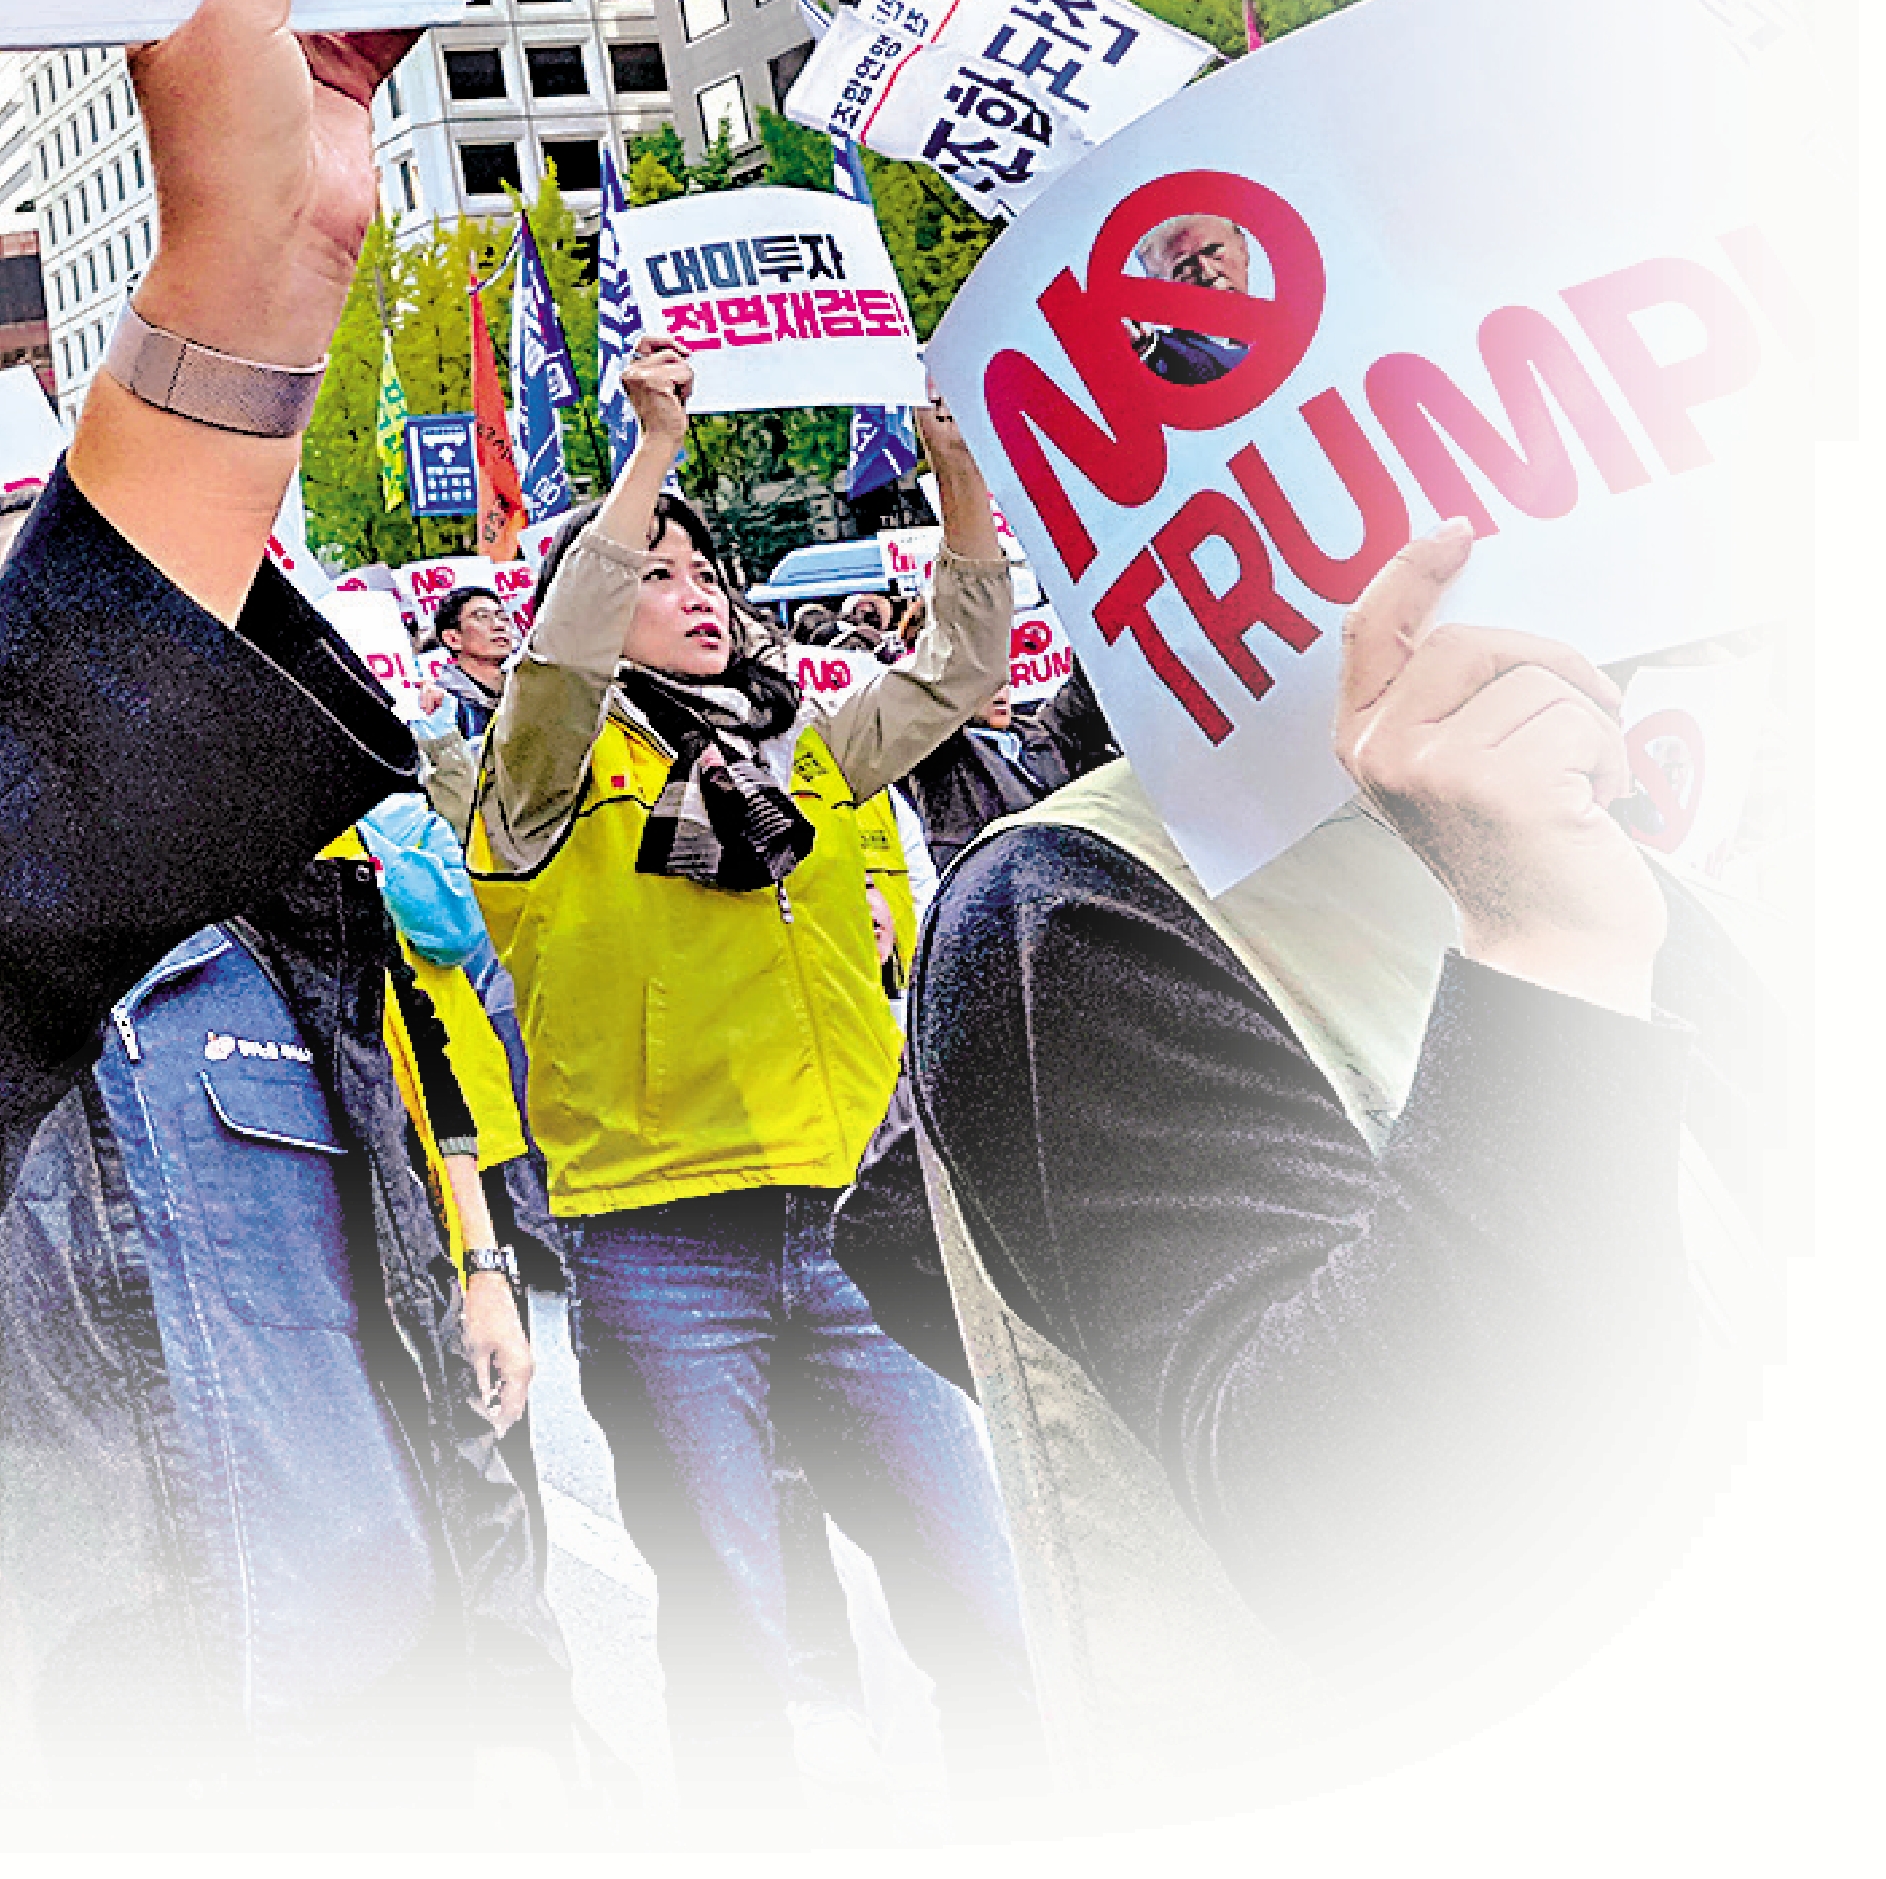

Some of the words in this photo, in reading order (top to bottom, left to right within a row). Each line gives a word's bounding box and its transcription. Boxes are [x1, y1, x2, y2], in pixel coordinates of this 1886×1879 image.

[646, 232, 846, 298] 대미투자
[661, 287, 911, 354] 전면재검토!
[983, 169, 1326, 583] NO
[797, 657, 852, 694] NO
